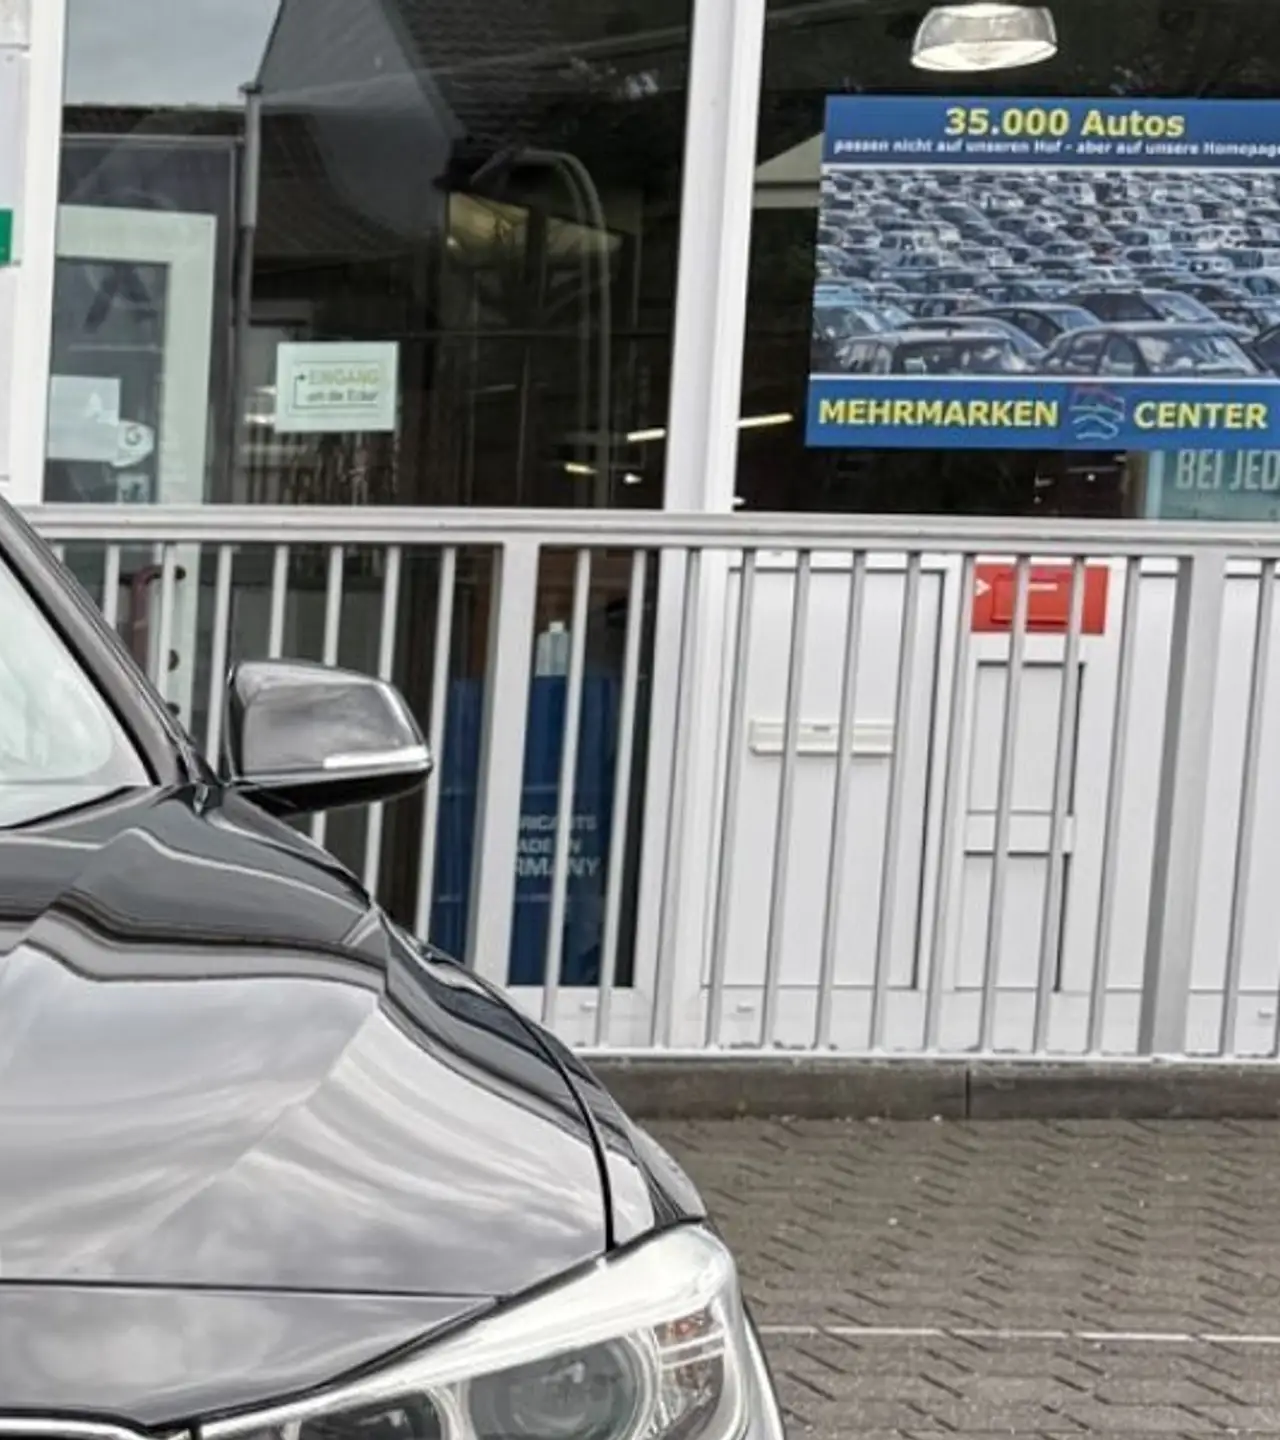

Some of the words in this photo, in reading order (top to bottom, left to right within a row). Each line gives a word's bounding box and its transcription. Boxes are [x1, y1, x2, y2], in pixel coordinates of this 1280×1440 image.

[944, 106, 1070, 136] 35.000
[1080, 109, 1185, 137] Autos
[893, 137, 932, 152] nicht
[936, 138, 964, 153] auf
[1076, 139, 1112, 154] aber
[1116, 139, 1143, 154] auf
[818, 398, 1058, 428] MEHRMARKEN
[1133, 401, 1268, 430] CENTER
[1176, 449, 1223, 490] BEI
